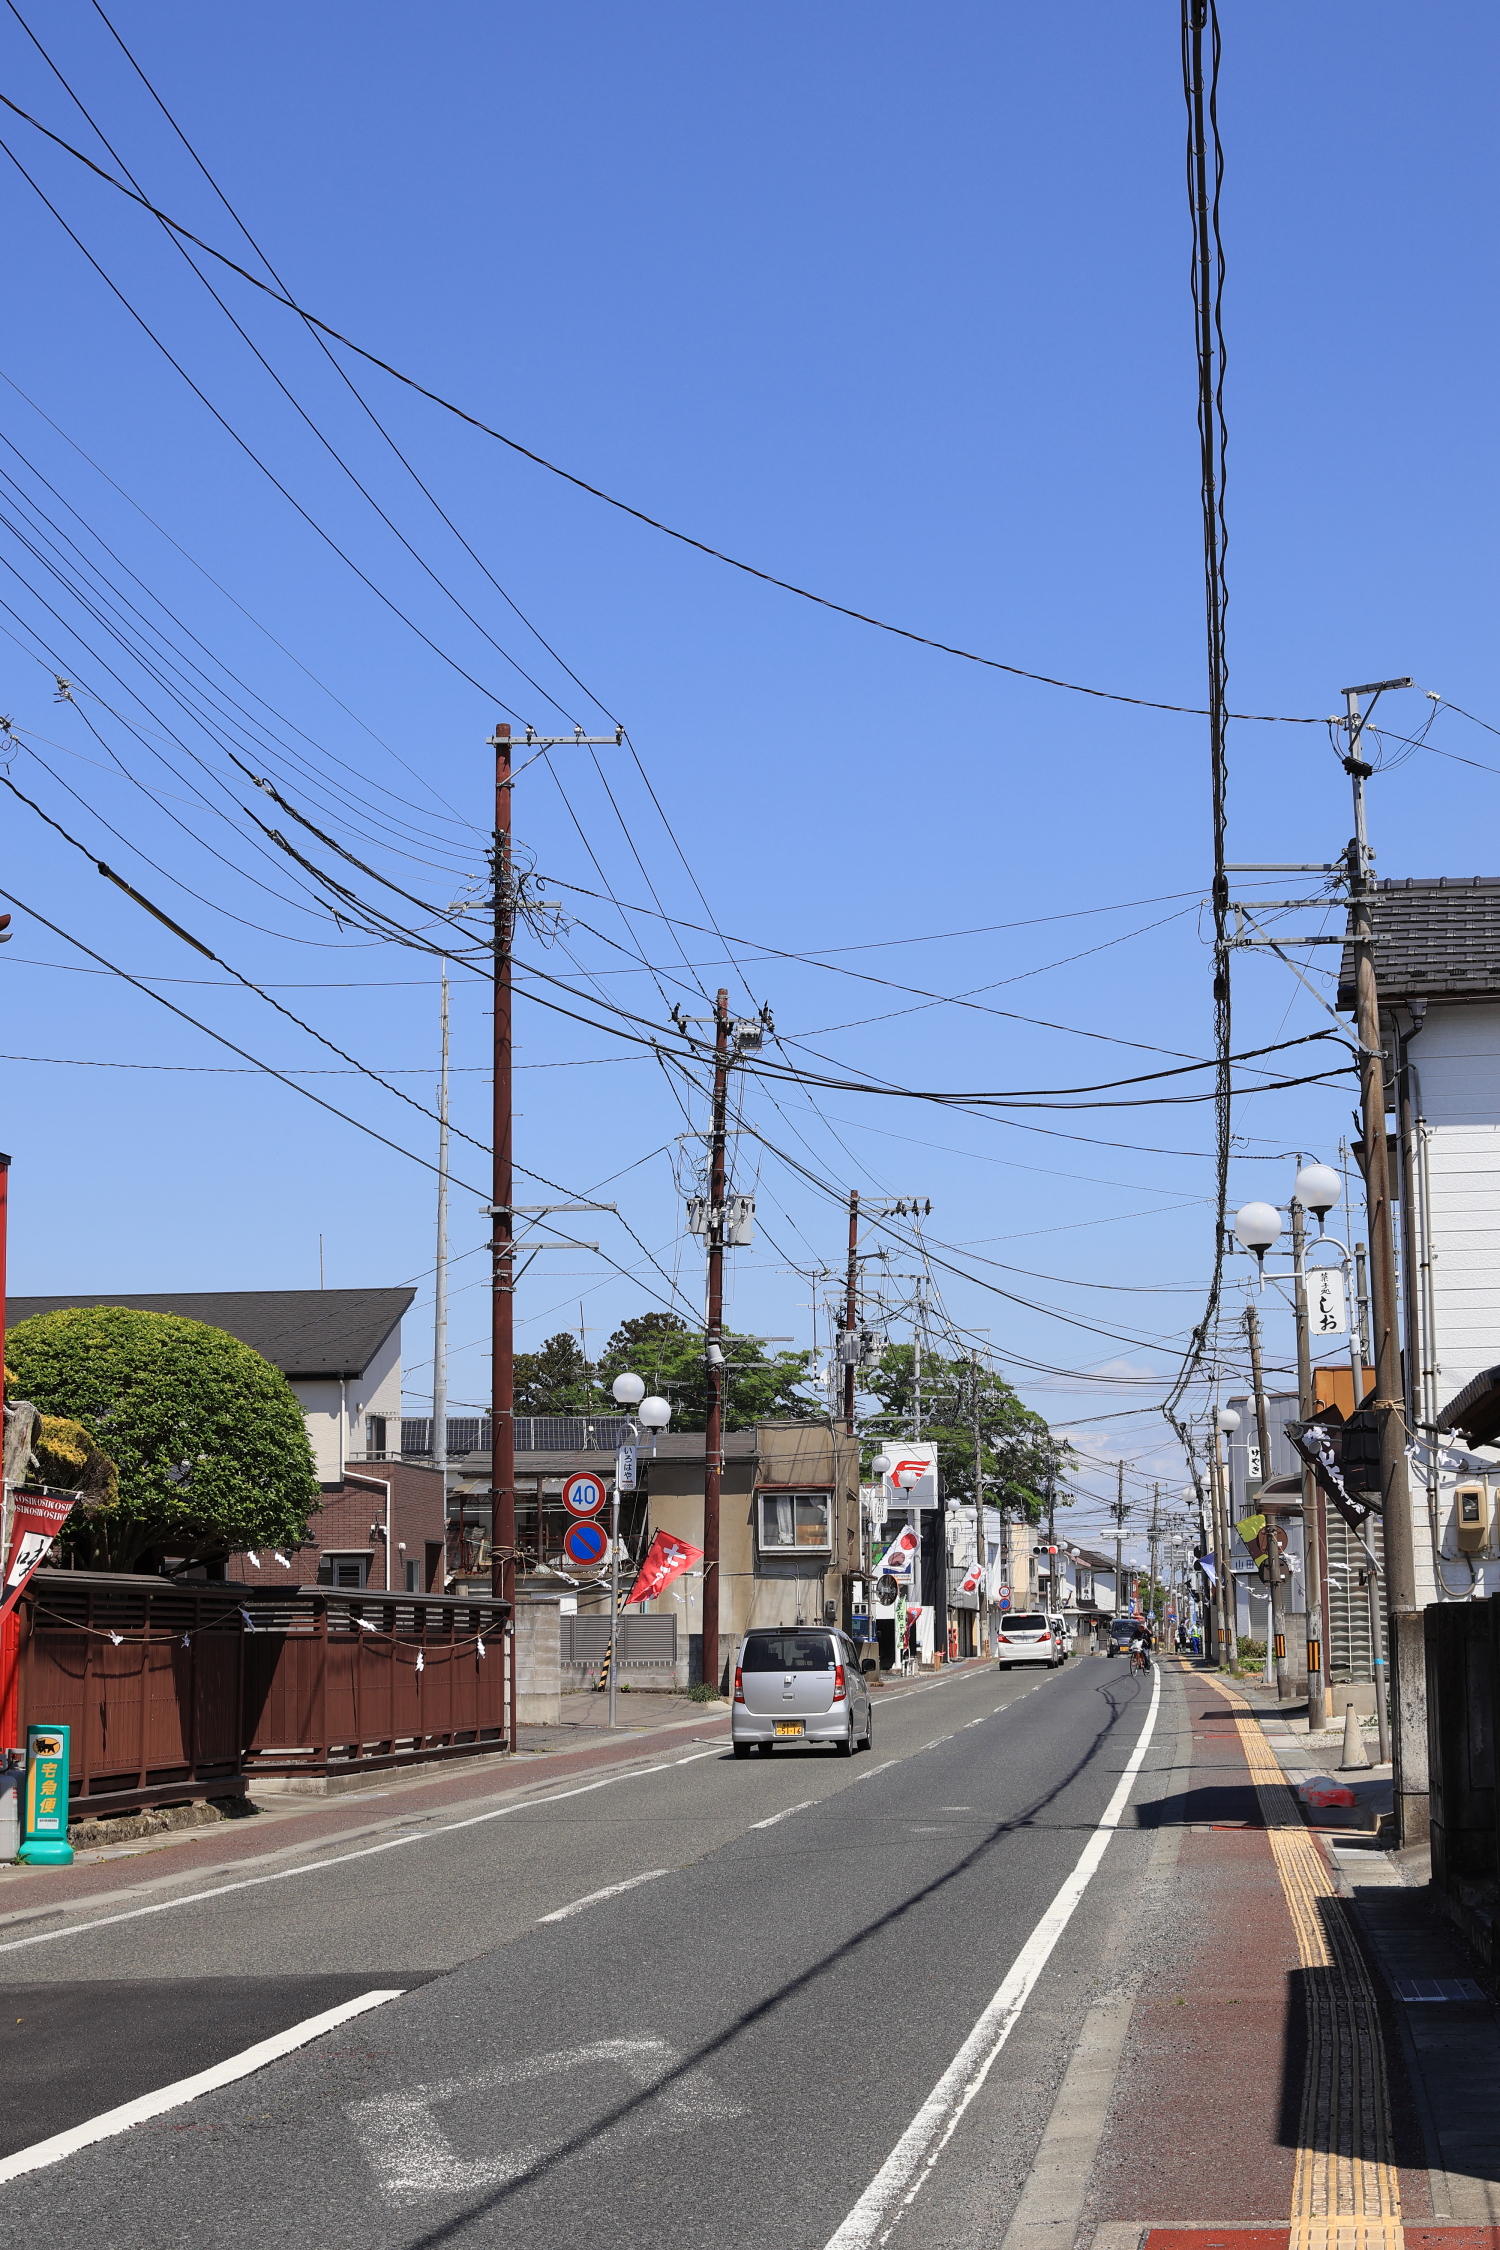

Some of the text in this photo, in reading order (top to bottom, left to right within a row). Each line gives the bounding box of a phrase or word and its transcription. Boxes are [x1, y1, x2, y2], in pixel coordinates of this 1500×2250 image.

[1319, 1296, 1337, 1331] しお
[623, 1446, 633, 1480] いろはや
[1251, 1448, 1260, 1475] けやき
[572, 1485, 596, 1505] 40
[1235, 1559, 1254, 1570] 山田
[39, 1761, 58, 1814] 宅急便
